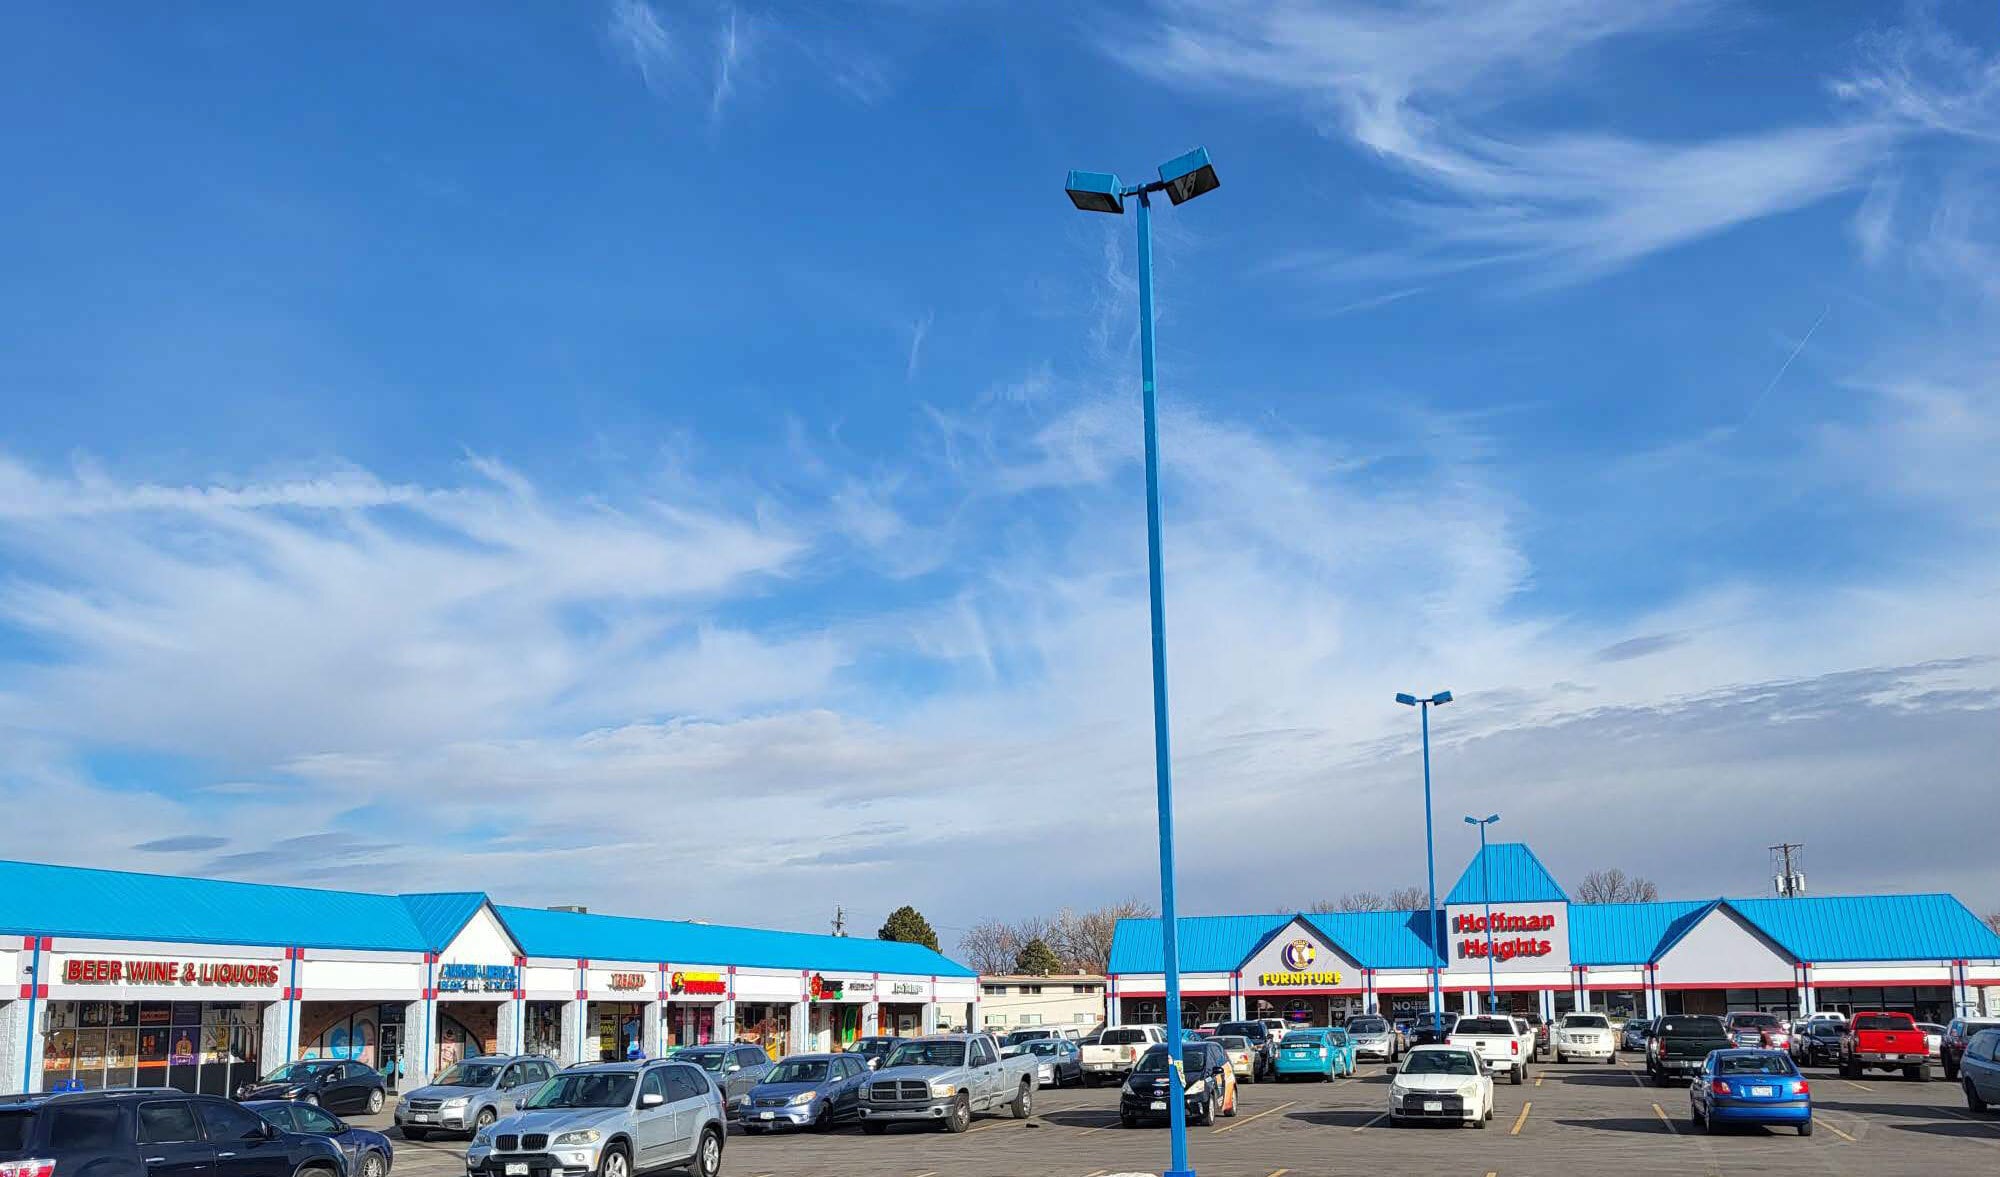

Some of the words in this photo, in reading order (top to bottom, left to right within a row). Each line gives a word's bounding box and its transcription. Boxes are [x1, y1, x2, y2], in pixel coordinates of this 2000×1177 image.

[1459, 912, 1555, 931] Hoffman
[1464, 937, 1552, 959] Heights
[66, 959, 122, 981] BEER
[128, 960, 179, 982] WINE
[185, 962, 197, 982] &
[203, 963, 279, 984] LIQUORS
[1262, 970, 1343, 985] FURNITURE
[1392, 1001, 1411, 1011] NO
